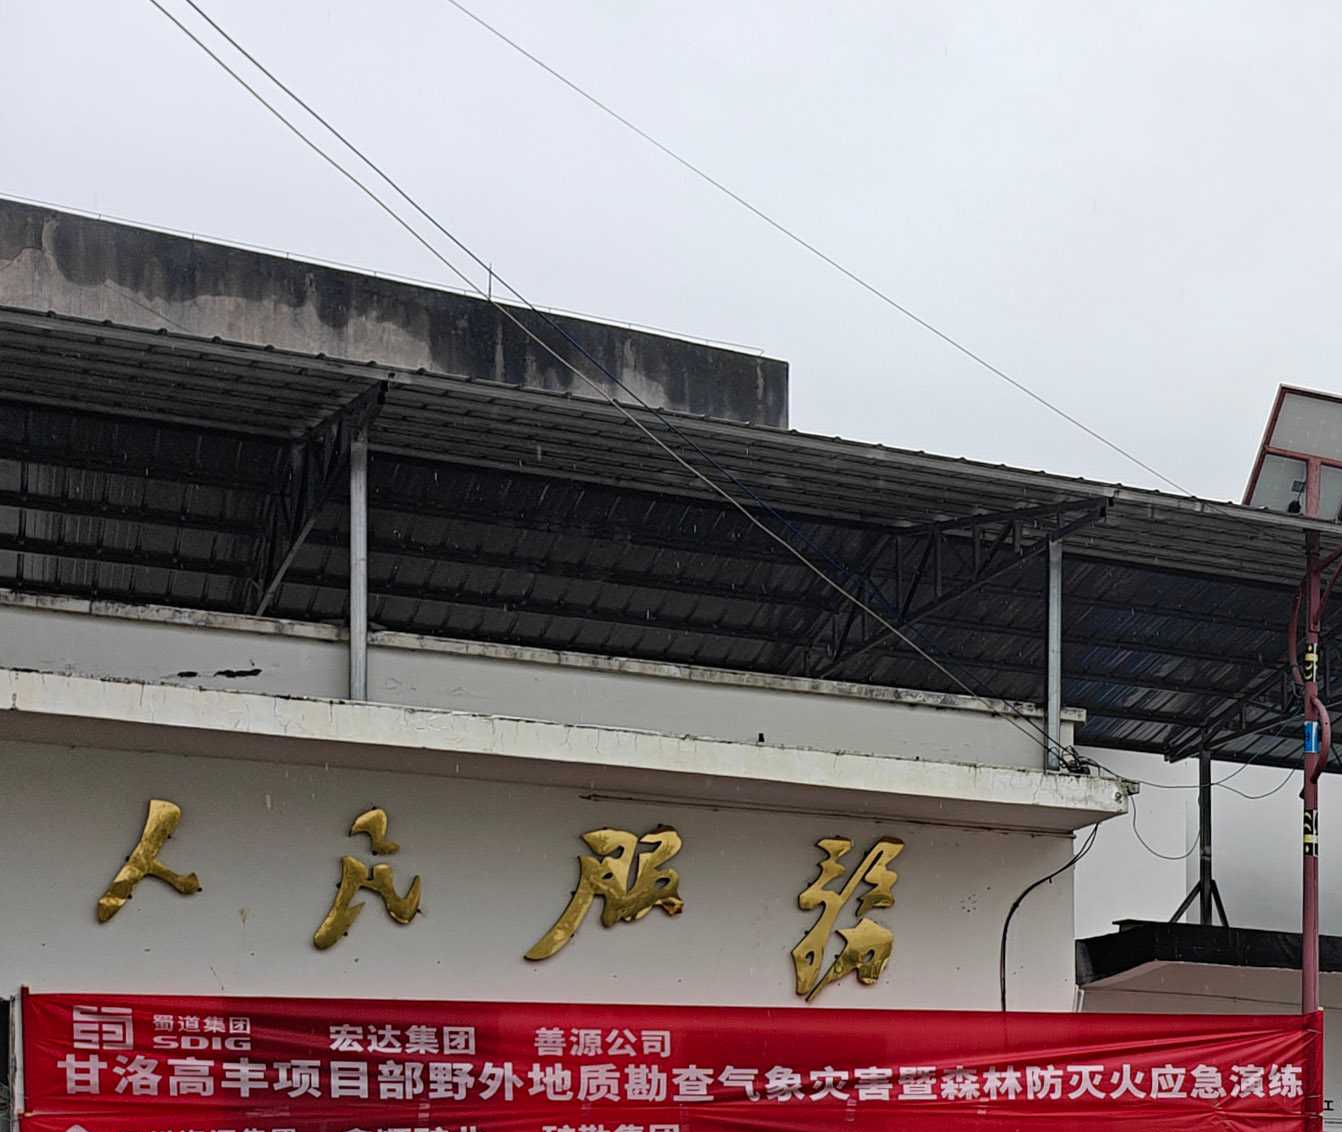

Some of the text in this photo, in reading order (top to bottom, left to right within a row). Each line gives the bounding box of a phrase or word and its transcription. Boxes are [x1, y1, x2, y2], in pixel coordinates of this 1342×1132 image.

[153, 1014, 251, 1034] 蜀道集团
[153, 1035, 252, 1051] SDIG
[328, 1024, 672, 1058] 宏达集团 善源公司
